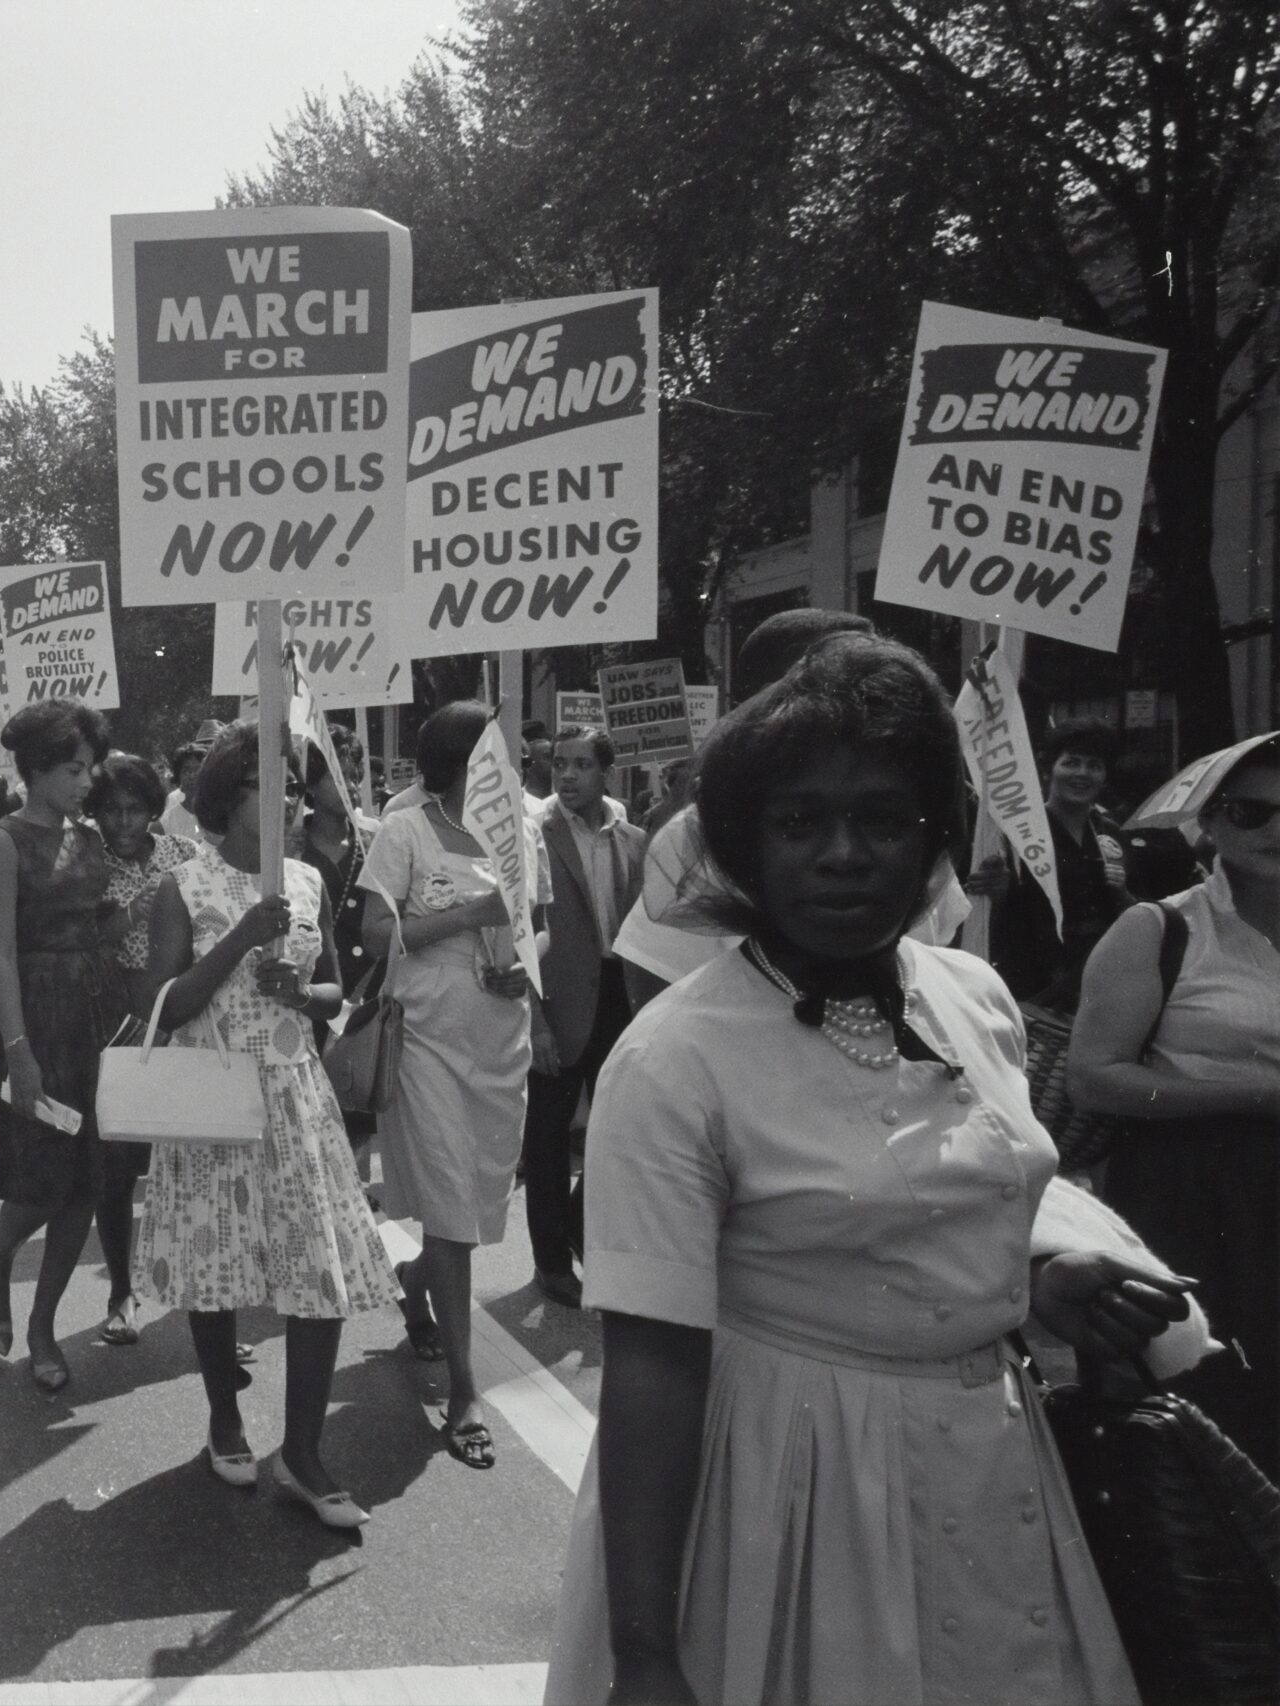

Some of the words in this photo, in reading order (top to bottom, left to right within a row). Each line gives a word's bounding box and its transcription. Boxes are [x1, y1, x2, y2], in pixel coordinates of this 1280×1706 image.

[226, 245, 300, 284] WE
[156, 288, 370, 343] MARCH
[224, 347, 306, 371] FOR
[471, 323, 563, 392] WE
[995, 349, 1084, 388] WE
[139, 389, 388, 442] INTEGRATED
[409, 354, 637, 467] DEMAND
[927, 391, 1140, 435] DEMAND
[141, 452, 384, 502] SCHOOLS
[431, 461, 624, 517] DECENT
[926, 453, 1003, 496] AN
[1020, 468, 1123, 521] END
[160, 504, 375, 578] NOW!
[412, 518, 642, 574] HOUSING
[927, 496, 989, 538] TO
[1003, 510, 1113, 566] BIAS
[34, 571, 70, 599] WE
[428, 557, 631, 631] NOW!
[918, 544, 1108, 616] NOW!
[11, 585, 100, 630] DEMAND
[245, 600, 373, 627] RGHTS
[20, 630, 50, 646] AN
[56, 628, 96, 643] END
[38, 648, 85, 664] POLICE
[25, 662, 95, 679] BRUTALITY
[27, 670, 108, 702] NOW!
[607, 671, 639, 683] UAW
[643, 665, 672, 678] SAYS
[564, 706, 602, 716] MARCH
[607, 682, 657, 705] JOBS
[660, 682, 680, 697] and
[608, 701, 685, 727] FREEDOM
[638, 726, 660, 735] FOR
[972, 675, 1031, 820] FREEDOM
[466, 751, 522, 891] FREEDOM
[1016, 822, 1033, 840] IN
[1023, 838, 1052, 878] '63
